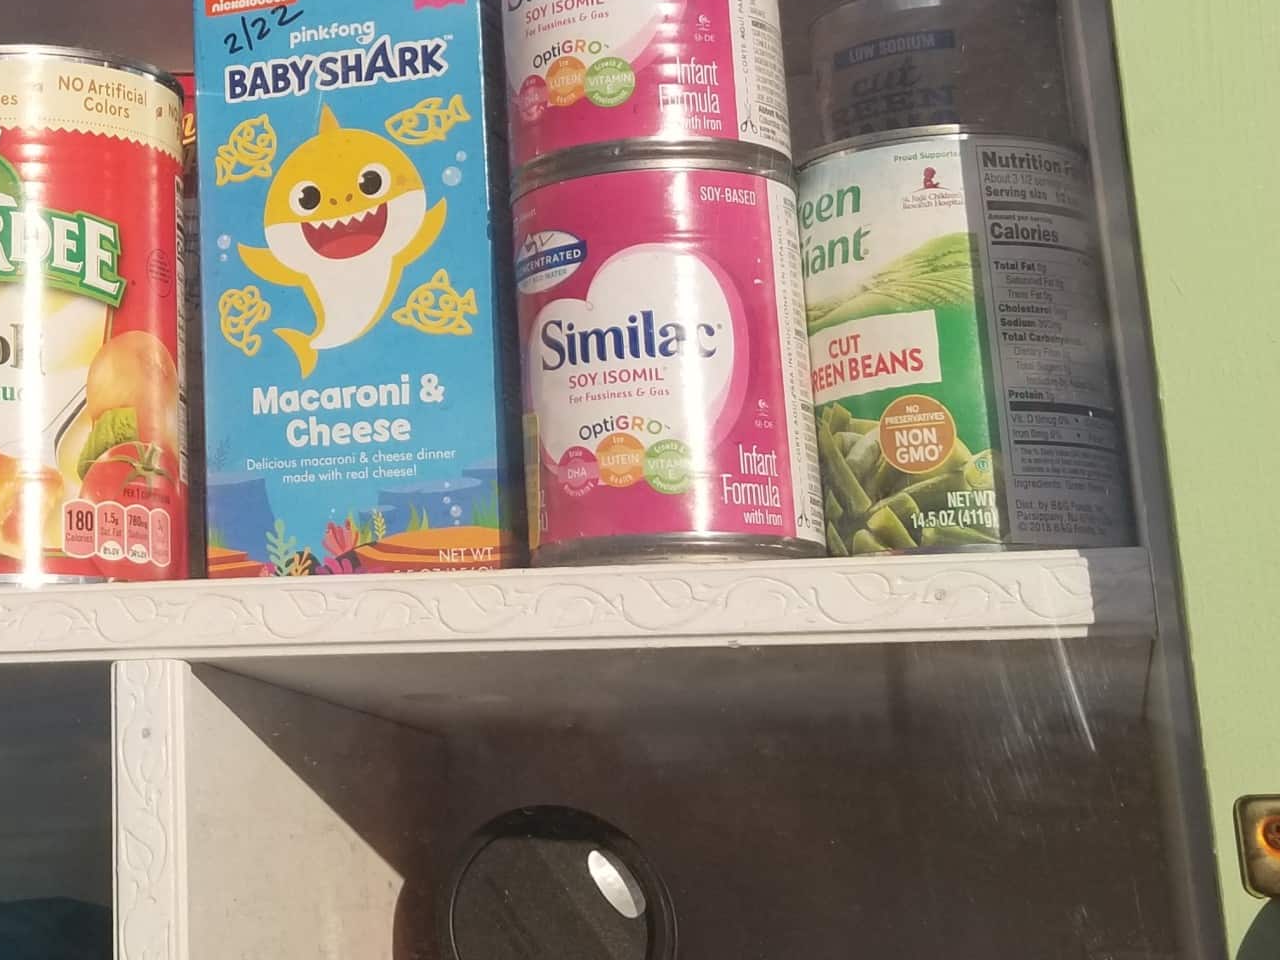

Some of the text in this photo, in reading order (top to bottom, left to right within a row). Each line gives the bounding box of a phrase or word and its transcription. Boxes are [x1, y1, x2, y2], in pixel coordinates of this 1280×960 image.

[525, 5, 548, 24] SOY
[223, 5, 305, 55] 2/22
[289, 20, 376, 49] pinkfong
[532, 40, 602, 68] OptiGRO
[879, 33, 936, 55] SODIUM
[228, 40, 445, 101] BABY SHARK
[589, 73, 632, 87] VITAMIN
[676, 56, 719, 86] Infant
[58, 75, 148, 107] NO Artificial
[83, 97, 130, 119] Colors
[703, 117, 722, 131] Iron
[982, 152, 1062, 173] Nutrition
[700, 185, 756, 206] SOY-BASED
[985, 185, 1027, 200] Serving
[799, 185, 861, 230] een
[990, 222, 1059, 243] Calories
[804, 227, 871, 278] iant
[993, 260, 1019, 271] Total
[1021, 262, 1036, 271] Fat
[1000, 318, 1037, 328] Sodium
[828, 334, 861, 359] CUT
[1001, 332, 1027, 342] Total
[569, 367, 665, 389] SOY ISOMIL
[811, 348, 924, 392] REEN BEANS
[252, 373, 445, 416] Macaroni &
[569, 387, 670, 404] For Fussiness & Gas
[1008, 390, 1044, 401] Protein
[884, 411, 945, 425] PRESERVATIVES
[905, 404, 920, 413] NO
[286, 416, 412, 448] Cheese
[579, 415, 663, 441] OptiGRO
[894, 427, 938, 447] NON
[246, 447, 457, 472] Delicious macaroni & cheese dinner
[601, 453, 641, 466] LUTEIN
[738, 444, 779, 477] Infant
[282, 464, 417, 483] made with real cheese!
[567, 467, 588, 479] DHA
[720, 473, 781, 507] Formula
[947, 490, 996, 509] NET WT
[67, 510, 94, 531] 180
[743, 508, 783, 526] with Iron
[911, 511, 936, 529] 14.5
[938, 510, 956, 527] OZ
[65, 532, 93, 543] Calories
[438, 547, 495, 563] NET WT
